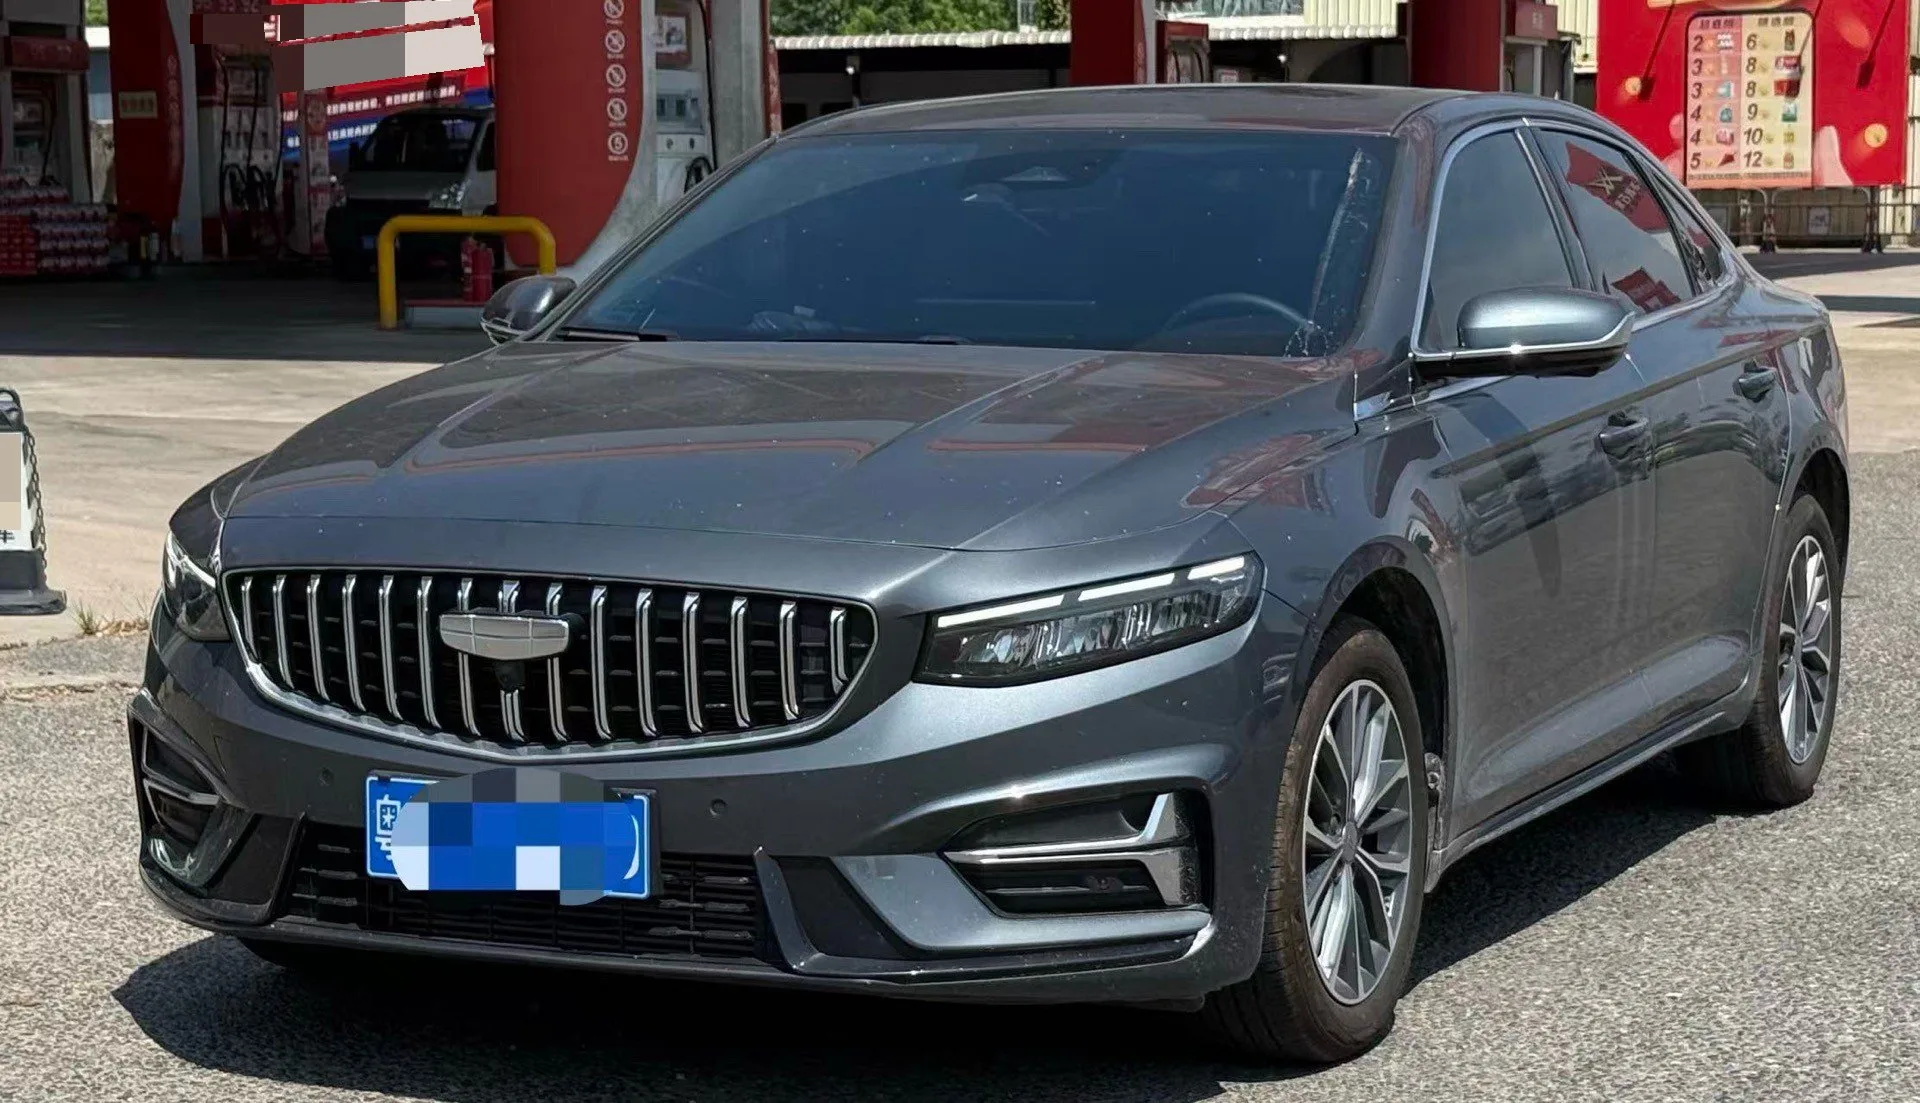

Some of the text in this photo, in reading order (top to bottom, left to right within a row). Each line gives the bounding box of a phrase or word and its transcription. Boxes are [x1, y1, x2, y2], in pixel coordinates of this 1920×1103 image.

[1692, 35, 1704, 52] 2
[1746, 33, 1759, 51] 6
[1691, 58, 1703, 76] 3
[1745, 56, 1757, 74] 8
[1691, 82, 1703, 99] 3
[1745, 80, 1757, 98] 8
[1690, 105, 1702, 122] 4
[1747, 103, 1759, 121] 9
[1690, 128, 1702, 146] 4
[1744, 127, 1763, 145] 10
[1690, 152, 1702, 170] 5
[1743, 151, 1763, 168] 12
